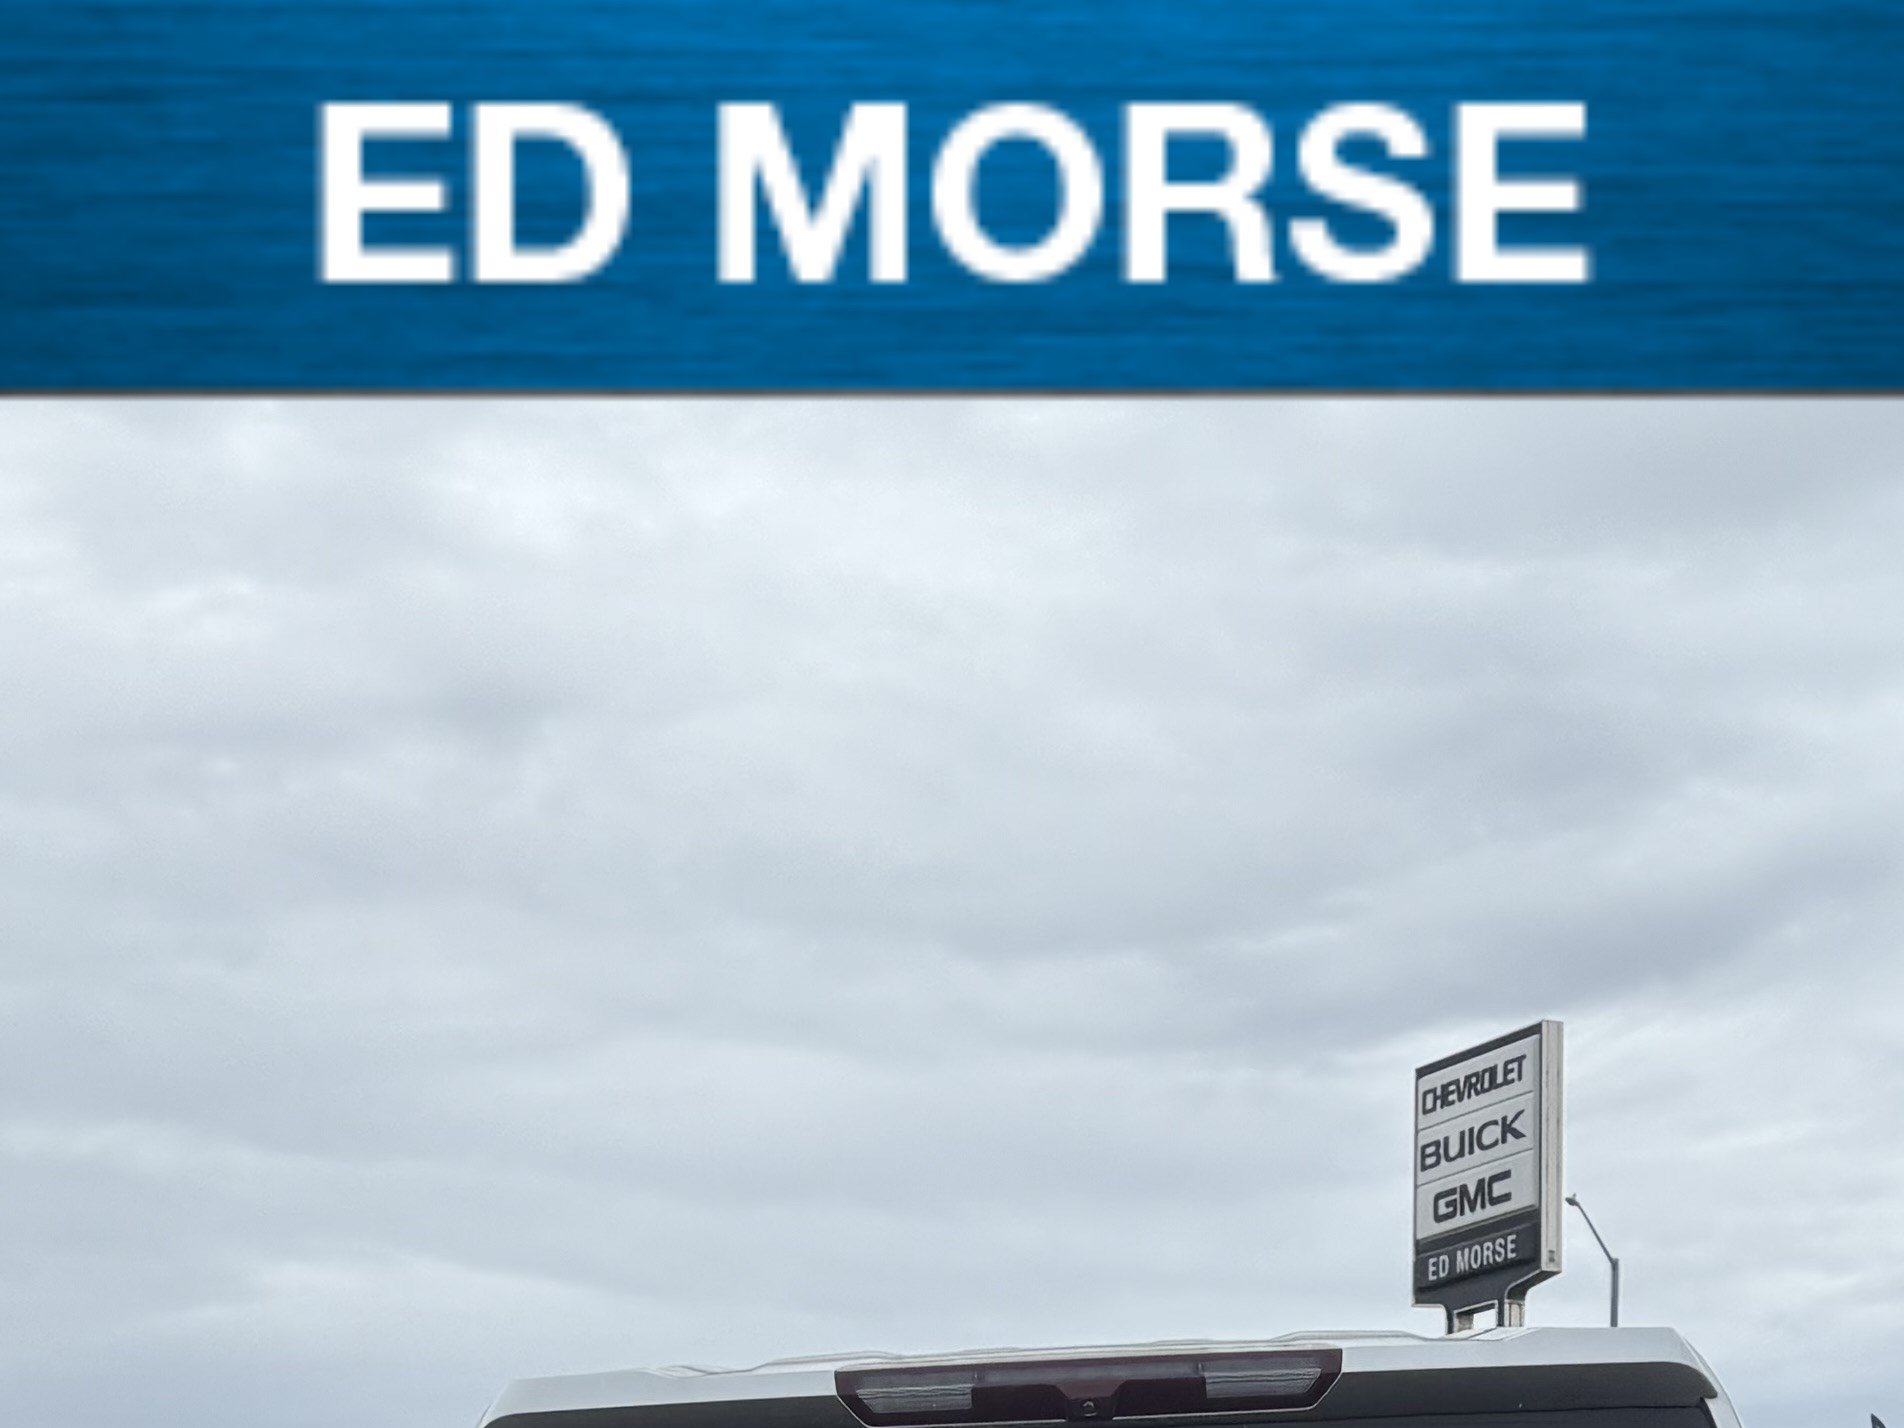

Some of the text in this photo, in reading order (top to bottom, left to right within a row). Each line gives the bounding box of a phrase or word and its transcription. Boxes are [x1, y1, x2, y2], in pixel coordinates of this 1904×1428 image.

[1421, 1054, 1527, 1116] CHEVROLET
[1419, 1108, 1527, 1173] BUICK
[1432, 1168, 1513, 1224] GMC
[1427, 1233, 1518, 1282] ED MORSE
